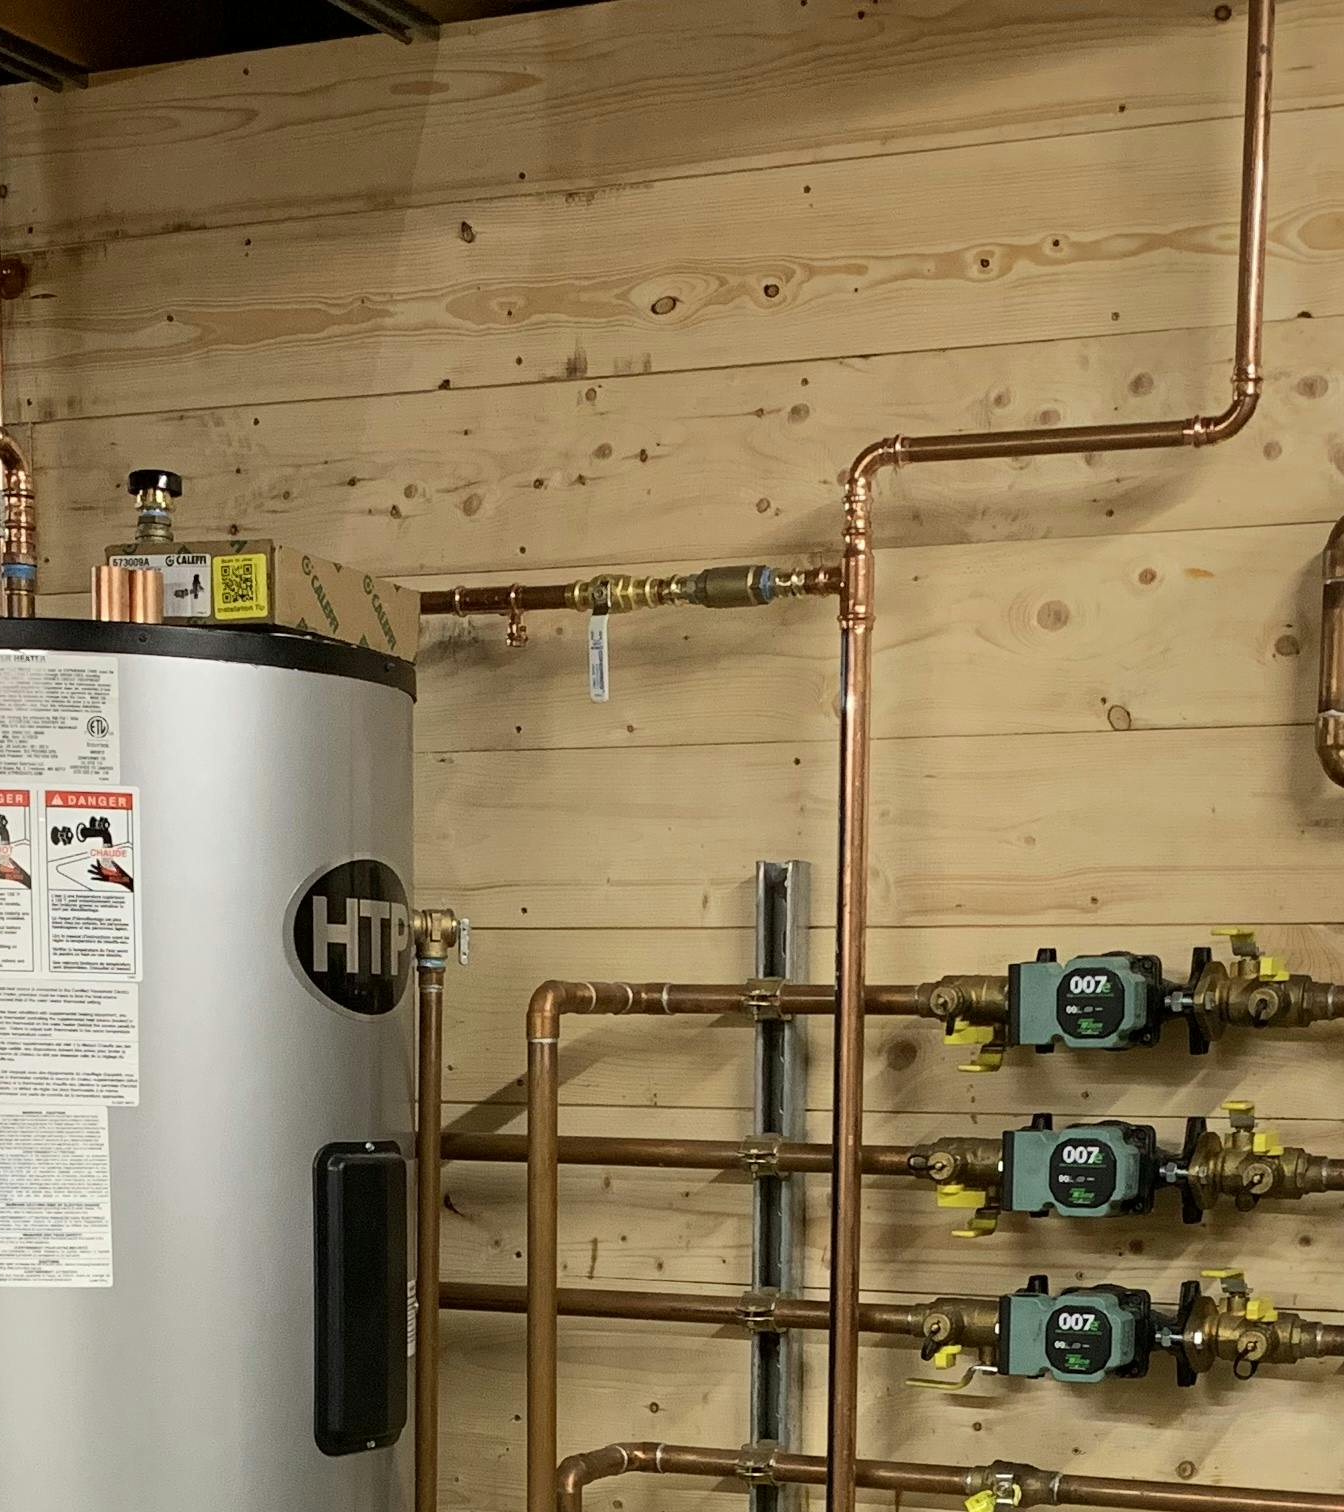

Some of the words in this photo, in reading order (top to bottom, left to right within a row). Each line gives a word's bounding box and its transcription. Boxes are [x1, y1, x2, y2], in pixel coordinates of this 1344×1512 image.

[176, 555, 207, 566] CALEFFI
[68, 795, 128, 807] DANGER
[90, 849, 127, 858] CHAUDE
[312, 895, 409, 976] HTP
